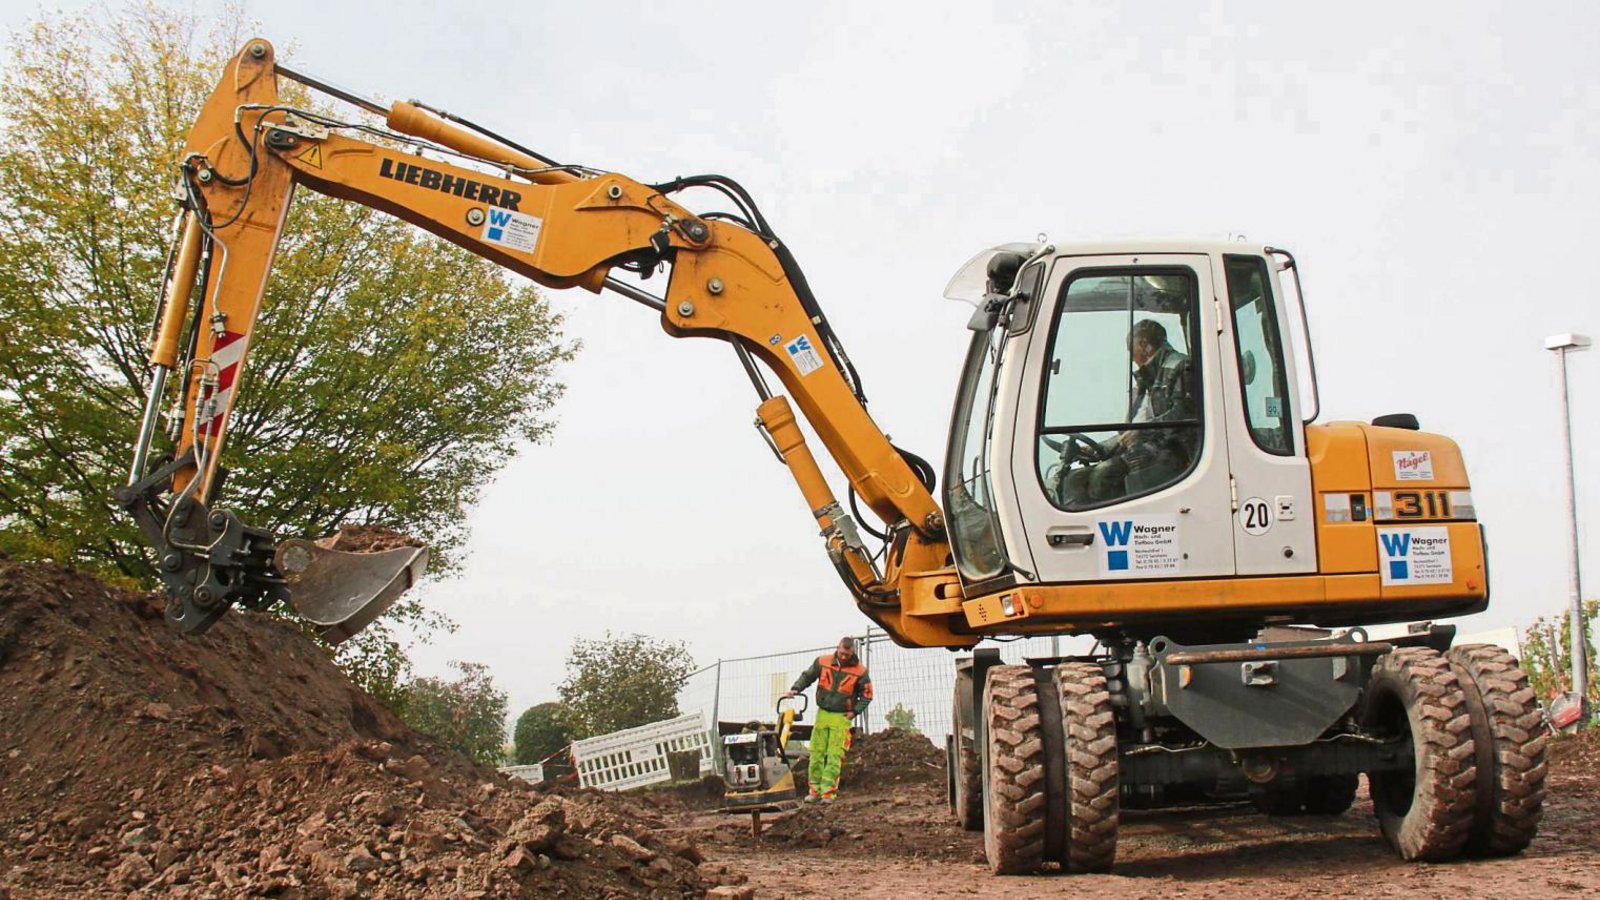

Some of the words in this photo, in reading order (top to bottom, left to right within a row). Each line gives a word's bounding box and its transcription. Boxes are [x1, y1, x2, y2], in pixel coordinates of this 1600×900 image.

[380, 158, 522, 212] LIEBHERR
[490, 209, 512, 228] W
[512, 218, 539, 229] Wagner
[1244, 502, 1268, 528] 20
[1394, 492, 1451, 518] 311
[1098, 521, 1133, 547] W
[1134, 525, 1176, 534] Wagner
[1411, 537, 1447, 545] Wagner
[1380, 533, 1411, 556] W
